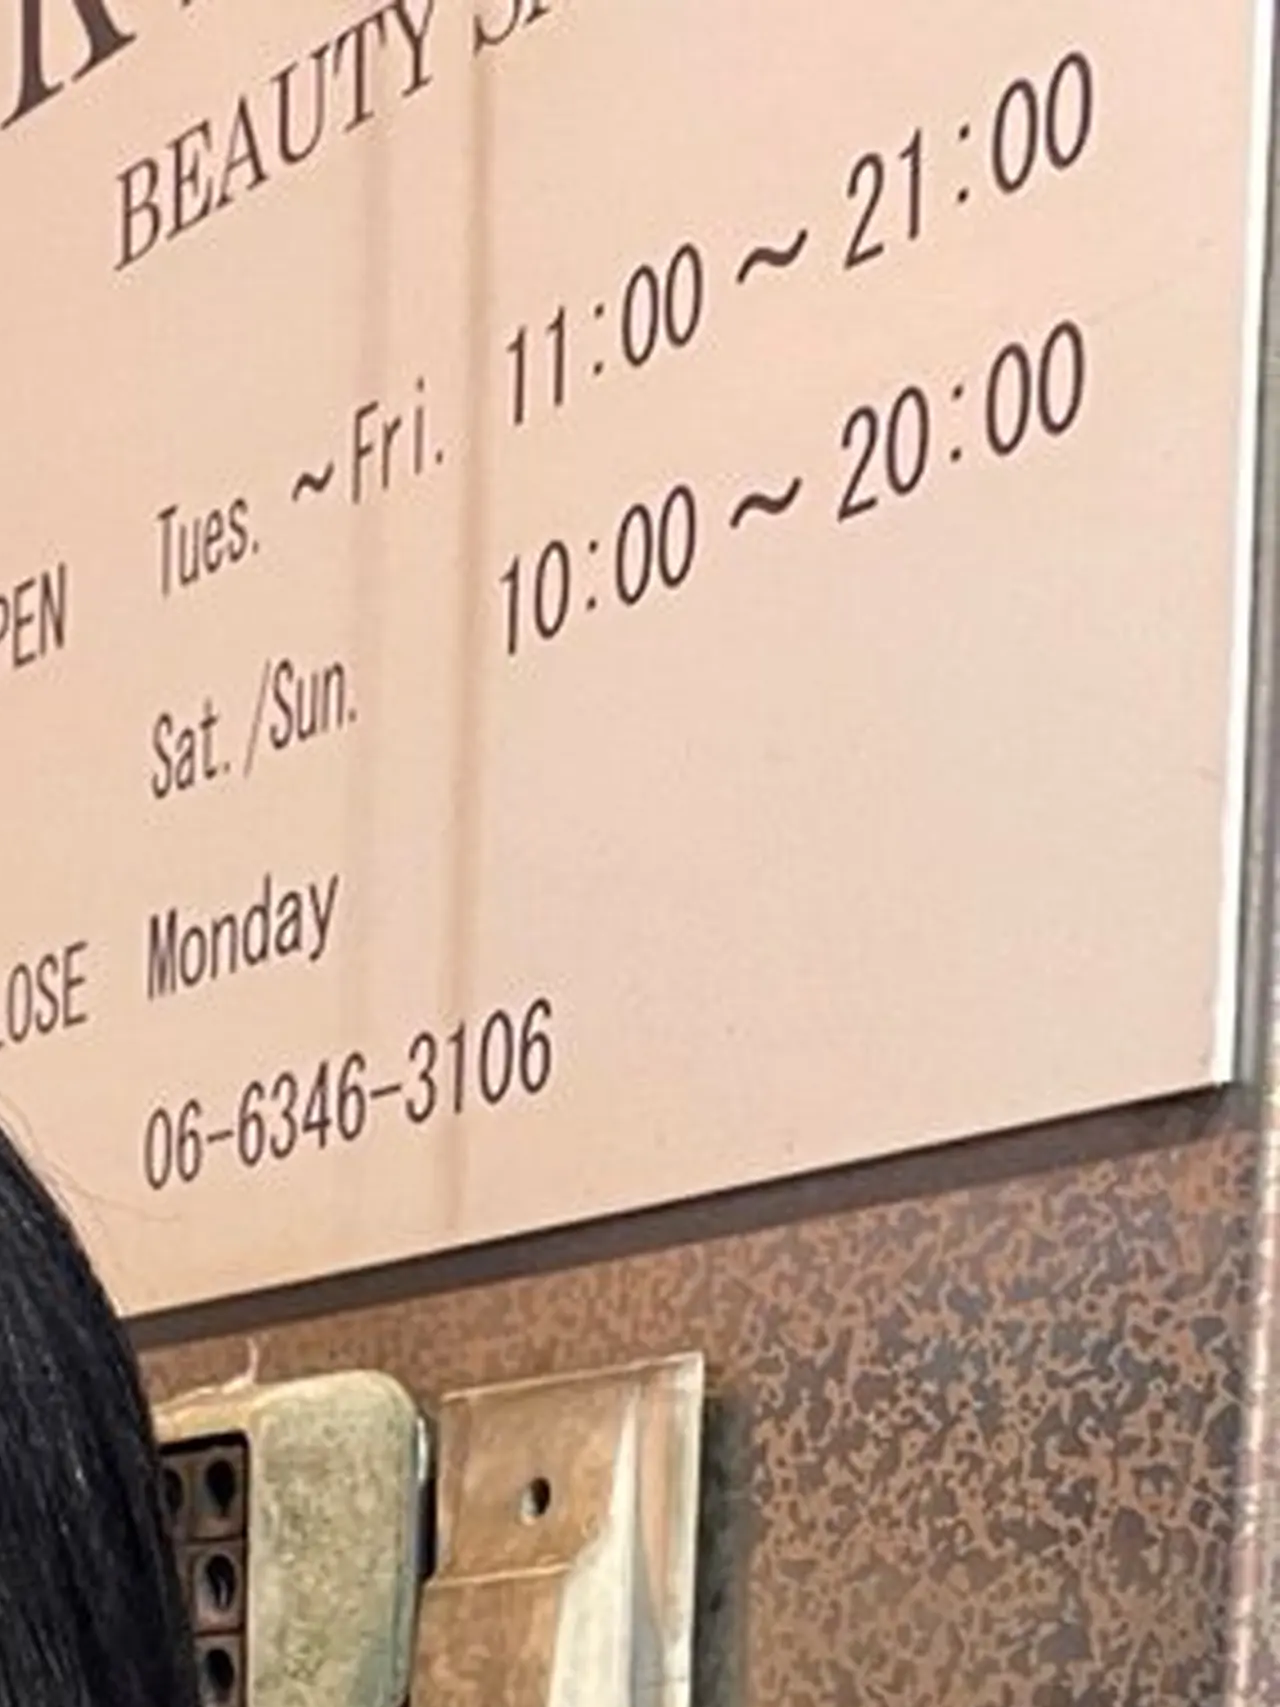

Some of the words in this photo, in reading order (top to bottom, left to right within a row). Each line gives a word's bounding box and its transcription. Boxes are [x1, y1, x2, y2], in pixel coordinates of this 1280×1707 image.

[114, 0, 435, 272] BEAUTY
[157, 497, 260, 596] Tues.
[147, 873, 339, 1000] Monday
[144, 997, 553, 1191] 06-6346-3106
